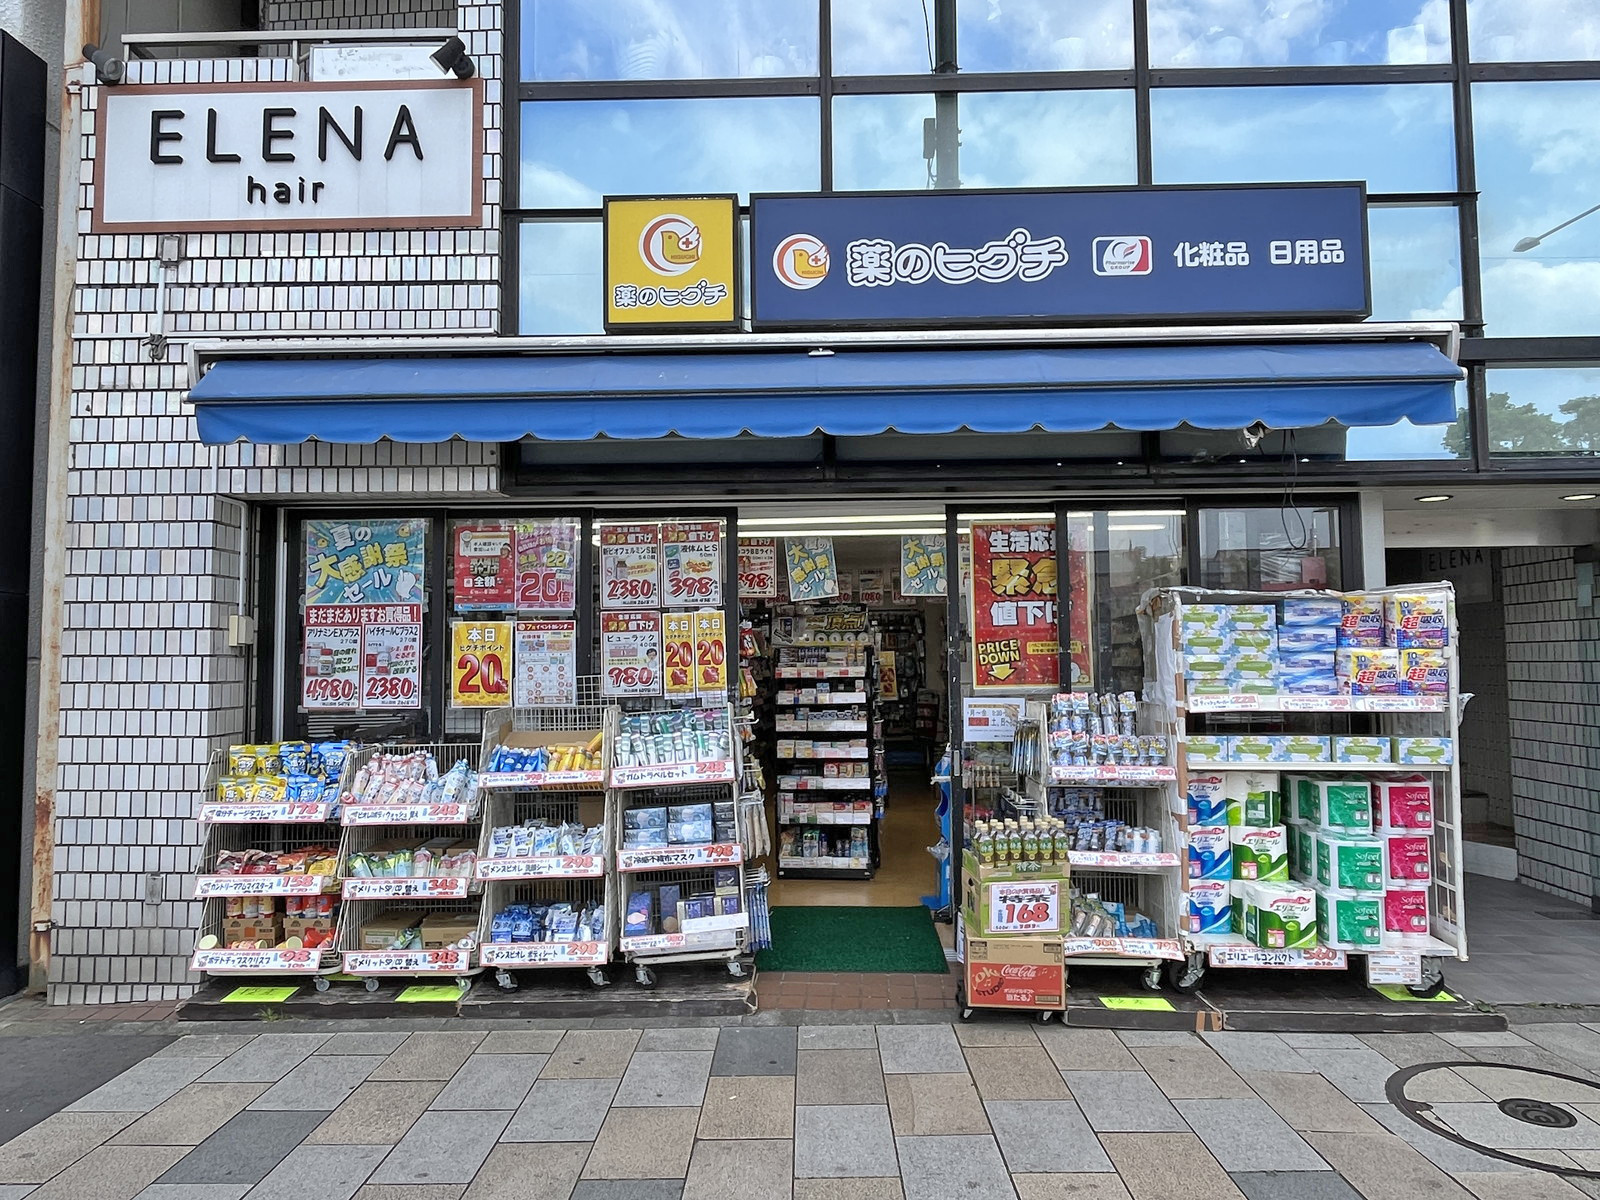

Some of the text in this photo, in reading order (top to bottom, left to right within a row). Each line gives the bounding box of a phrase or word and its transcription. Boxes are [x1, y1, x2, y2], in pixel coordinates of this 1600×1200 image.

[150, 104, 424, 164] ELENA
[247, 175, 325, 204] hair
[846, 228, 1069, 286] 薬のヒグチ
[1173, 239, 1345, 267] 化粧品 日用品
[614, 279, 727, 308] 薬のヒグチ
[330, 524, 372, 551] 夏の
[681, 544, 718, 553] 液体ムヒS
[309, 542, 409, 588] 大感謝祭
[1428, 549, 1484, 572] ELENA
[474, 576, 496, 588] 全額
[800, 570, 826, 593] セール
[911, 567, 939, 589] セール
[343, 568, 392, 602] セール
[607, 580, 653, 600] 2380
[669, 577, 714, 598] 398
[668, 620, 689, 632] 本日
[699, 618, 720, 630] 本日
[1401, 615, 1444, 629] 超吸収
[307, 628, 360, 638] アリナミンEXプラス
[366, 626, 419, 636] ハイチオールCプラス2
[467, 627, 496, 642] 本日
[607, 634, 655, 643] ビューラック
[460, 644, 504, 652] ヒグチポイント
[697, 639, 725, 666] 20
[977, 639, 1019, 654] PRICE
[665, 641, 693, 668] 20
[979, 650, 1020, 666] DOWN
[608, 667, 654, 688] 980
[1357, 670, 1397, 684] 超吸収
[1408, 668, 1449, 681] 超吸収
[306, 678, 355, 701] 4980
[366, 677, 416, 700] 2380
[626, 762, 726, 781] ガムトラベルセット 248
[1188, 784, 1220, 792] エリエール
[1344, 791, 1367, 800] Sofeel
[1406, 791, 1429, 800] Sofeel
[288, 803, 319, 815] 178
[428, 805, 460, 816] 248
[1190, 835, 1223, 844] エリエール
[1246, 837, 1281, 846] エリエール
[703, 845, 734, 858] 798
[1405, 842, 1427, 852] Sofeel
[562, 856, 593, 869] 298
[1355, 852, 1381, 861] Sofeel
[1016, 861, 1040, 872] 特茶
[282, 876, 314, 888] 158
[428, 878, 459, 890] 348
[1190, 891, 1223, 899] エリエール
[1401, 896, 1424, 905] Sofeel
[1005, 902, 1050, 924] 168
[1273, 904, 1309, 913] エリエール
[1354, 906, 1378, 915] Sofeel
[527, 950, 558, 958] ボディシート
[567, 943, 598, 956] 298
[208, 950, 311, 966] ポテトチップスクリスプ 98
[428, 951, 460, 964] 348
[1227, 952, 1295, 963] エリエールコンパクト
